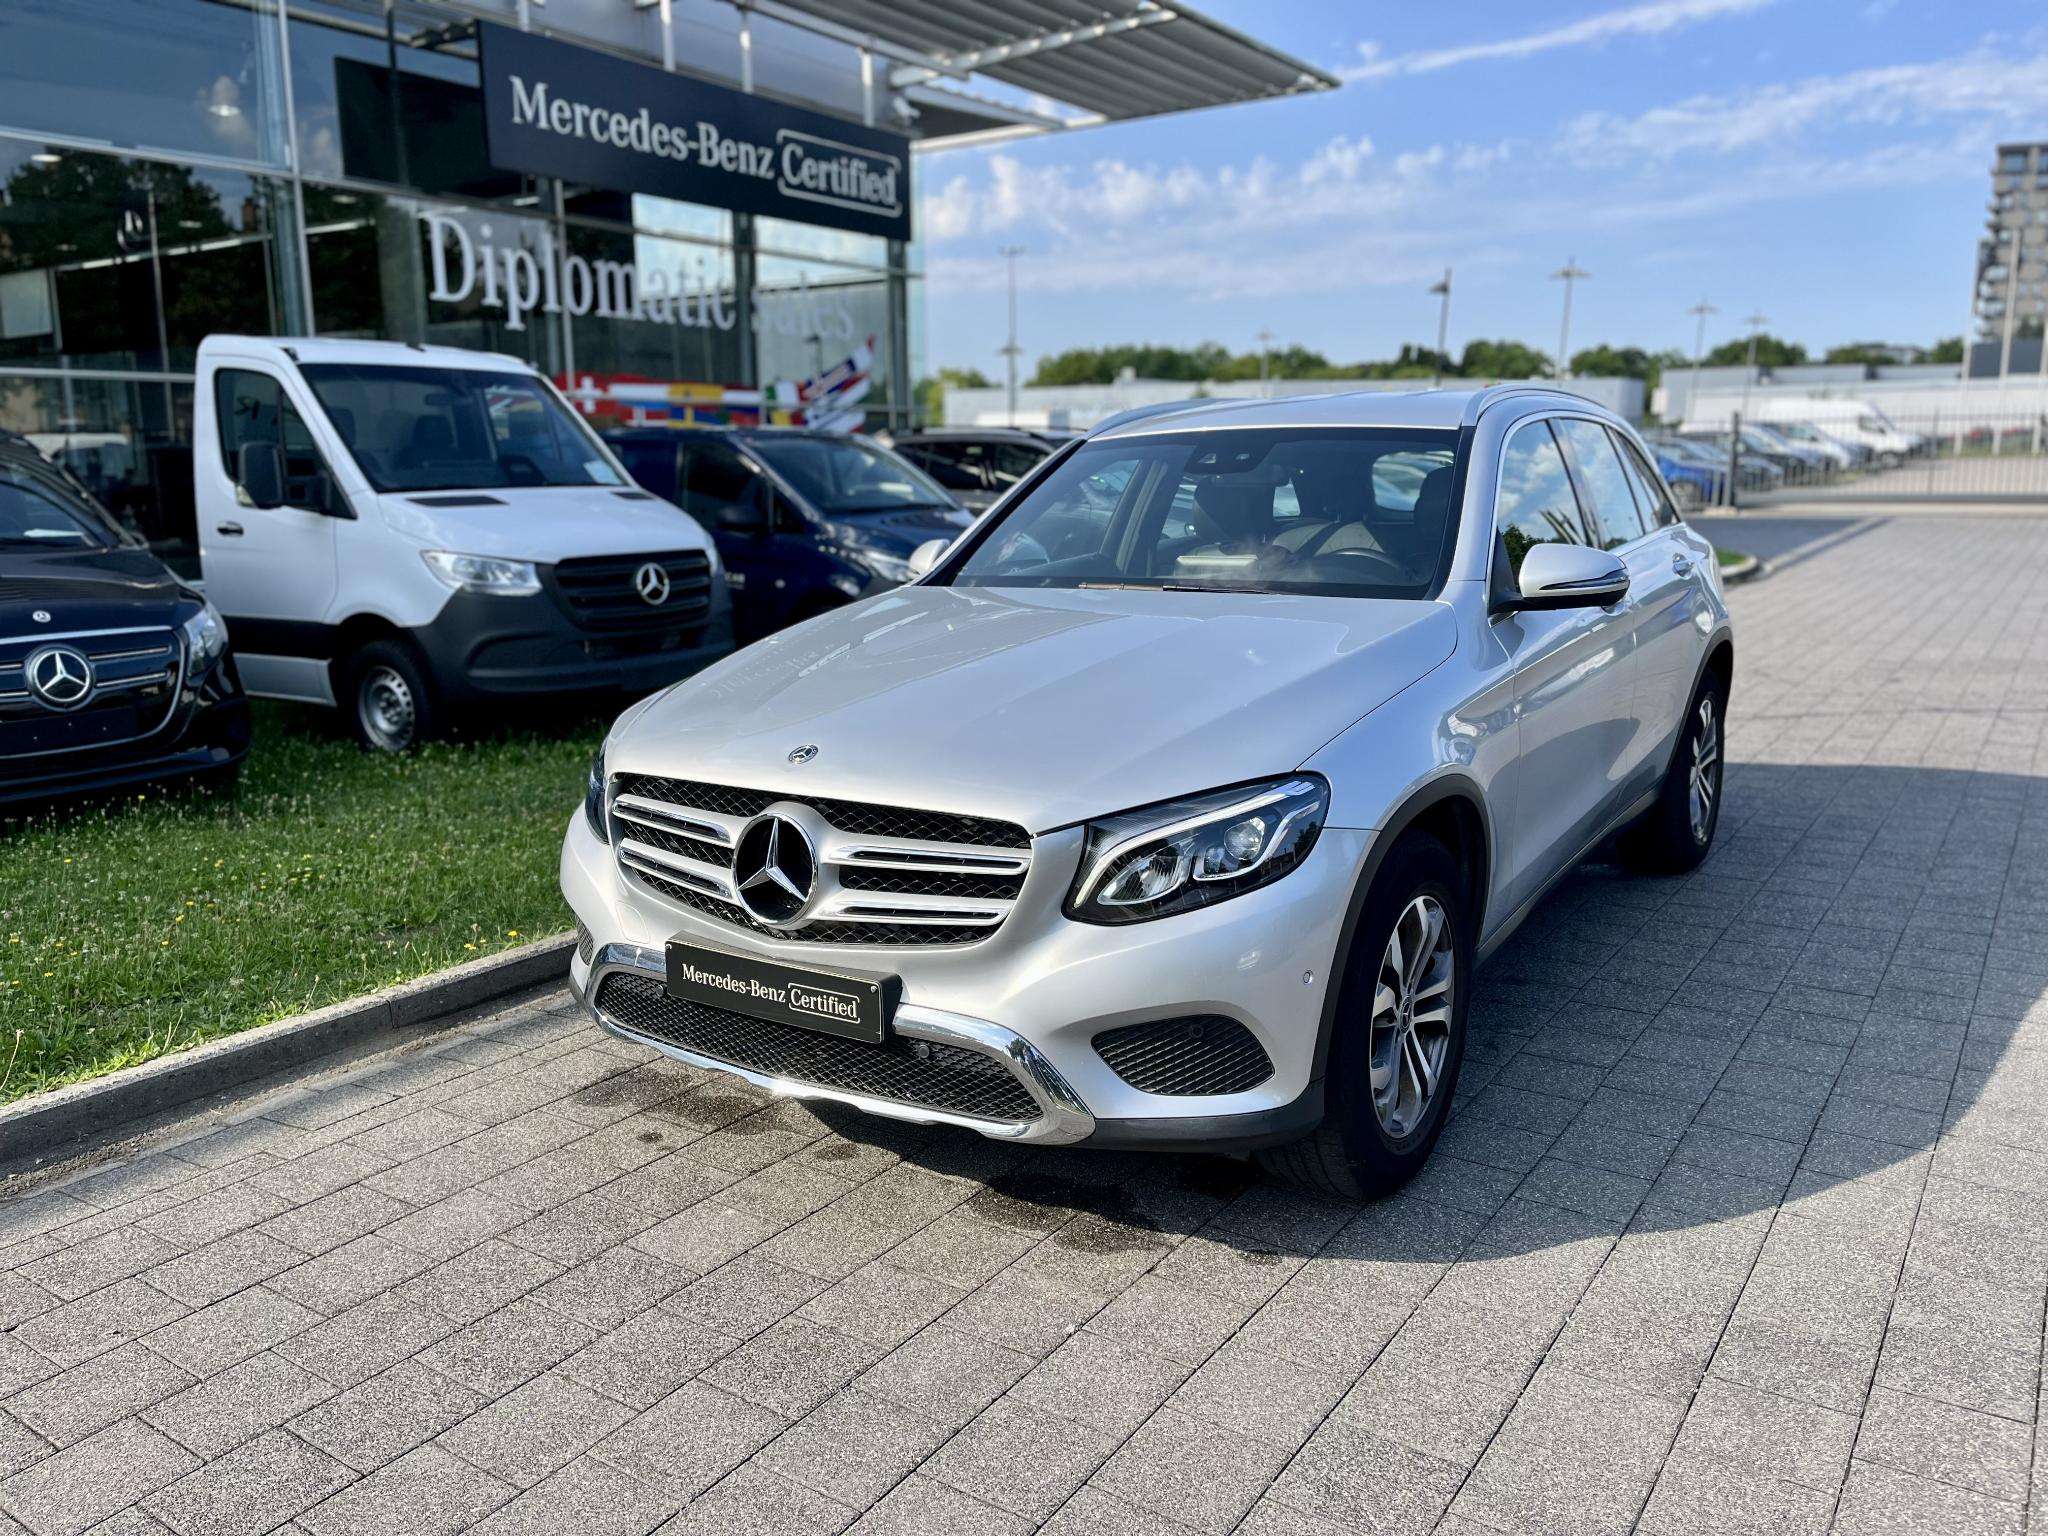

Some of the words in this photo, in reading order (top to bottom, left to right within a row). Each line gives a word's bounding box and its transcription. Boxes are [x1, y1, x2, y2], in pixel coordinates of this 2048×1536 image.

[508, 74, 775, 180] Mercedes-Benz
[781, 142, 897, 206] Certified
[419, 212, 737, 332] Diplomatic
[681, 963, 787, 1003] Mercedes-Benz
[790, 989, 858, 1019] Certified
